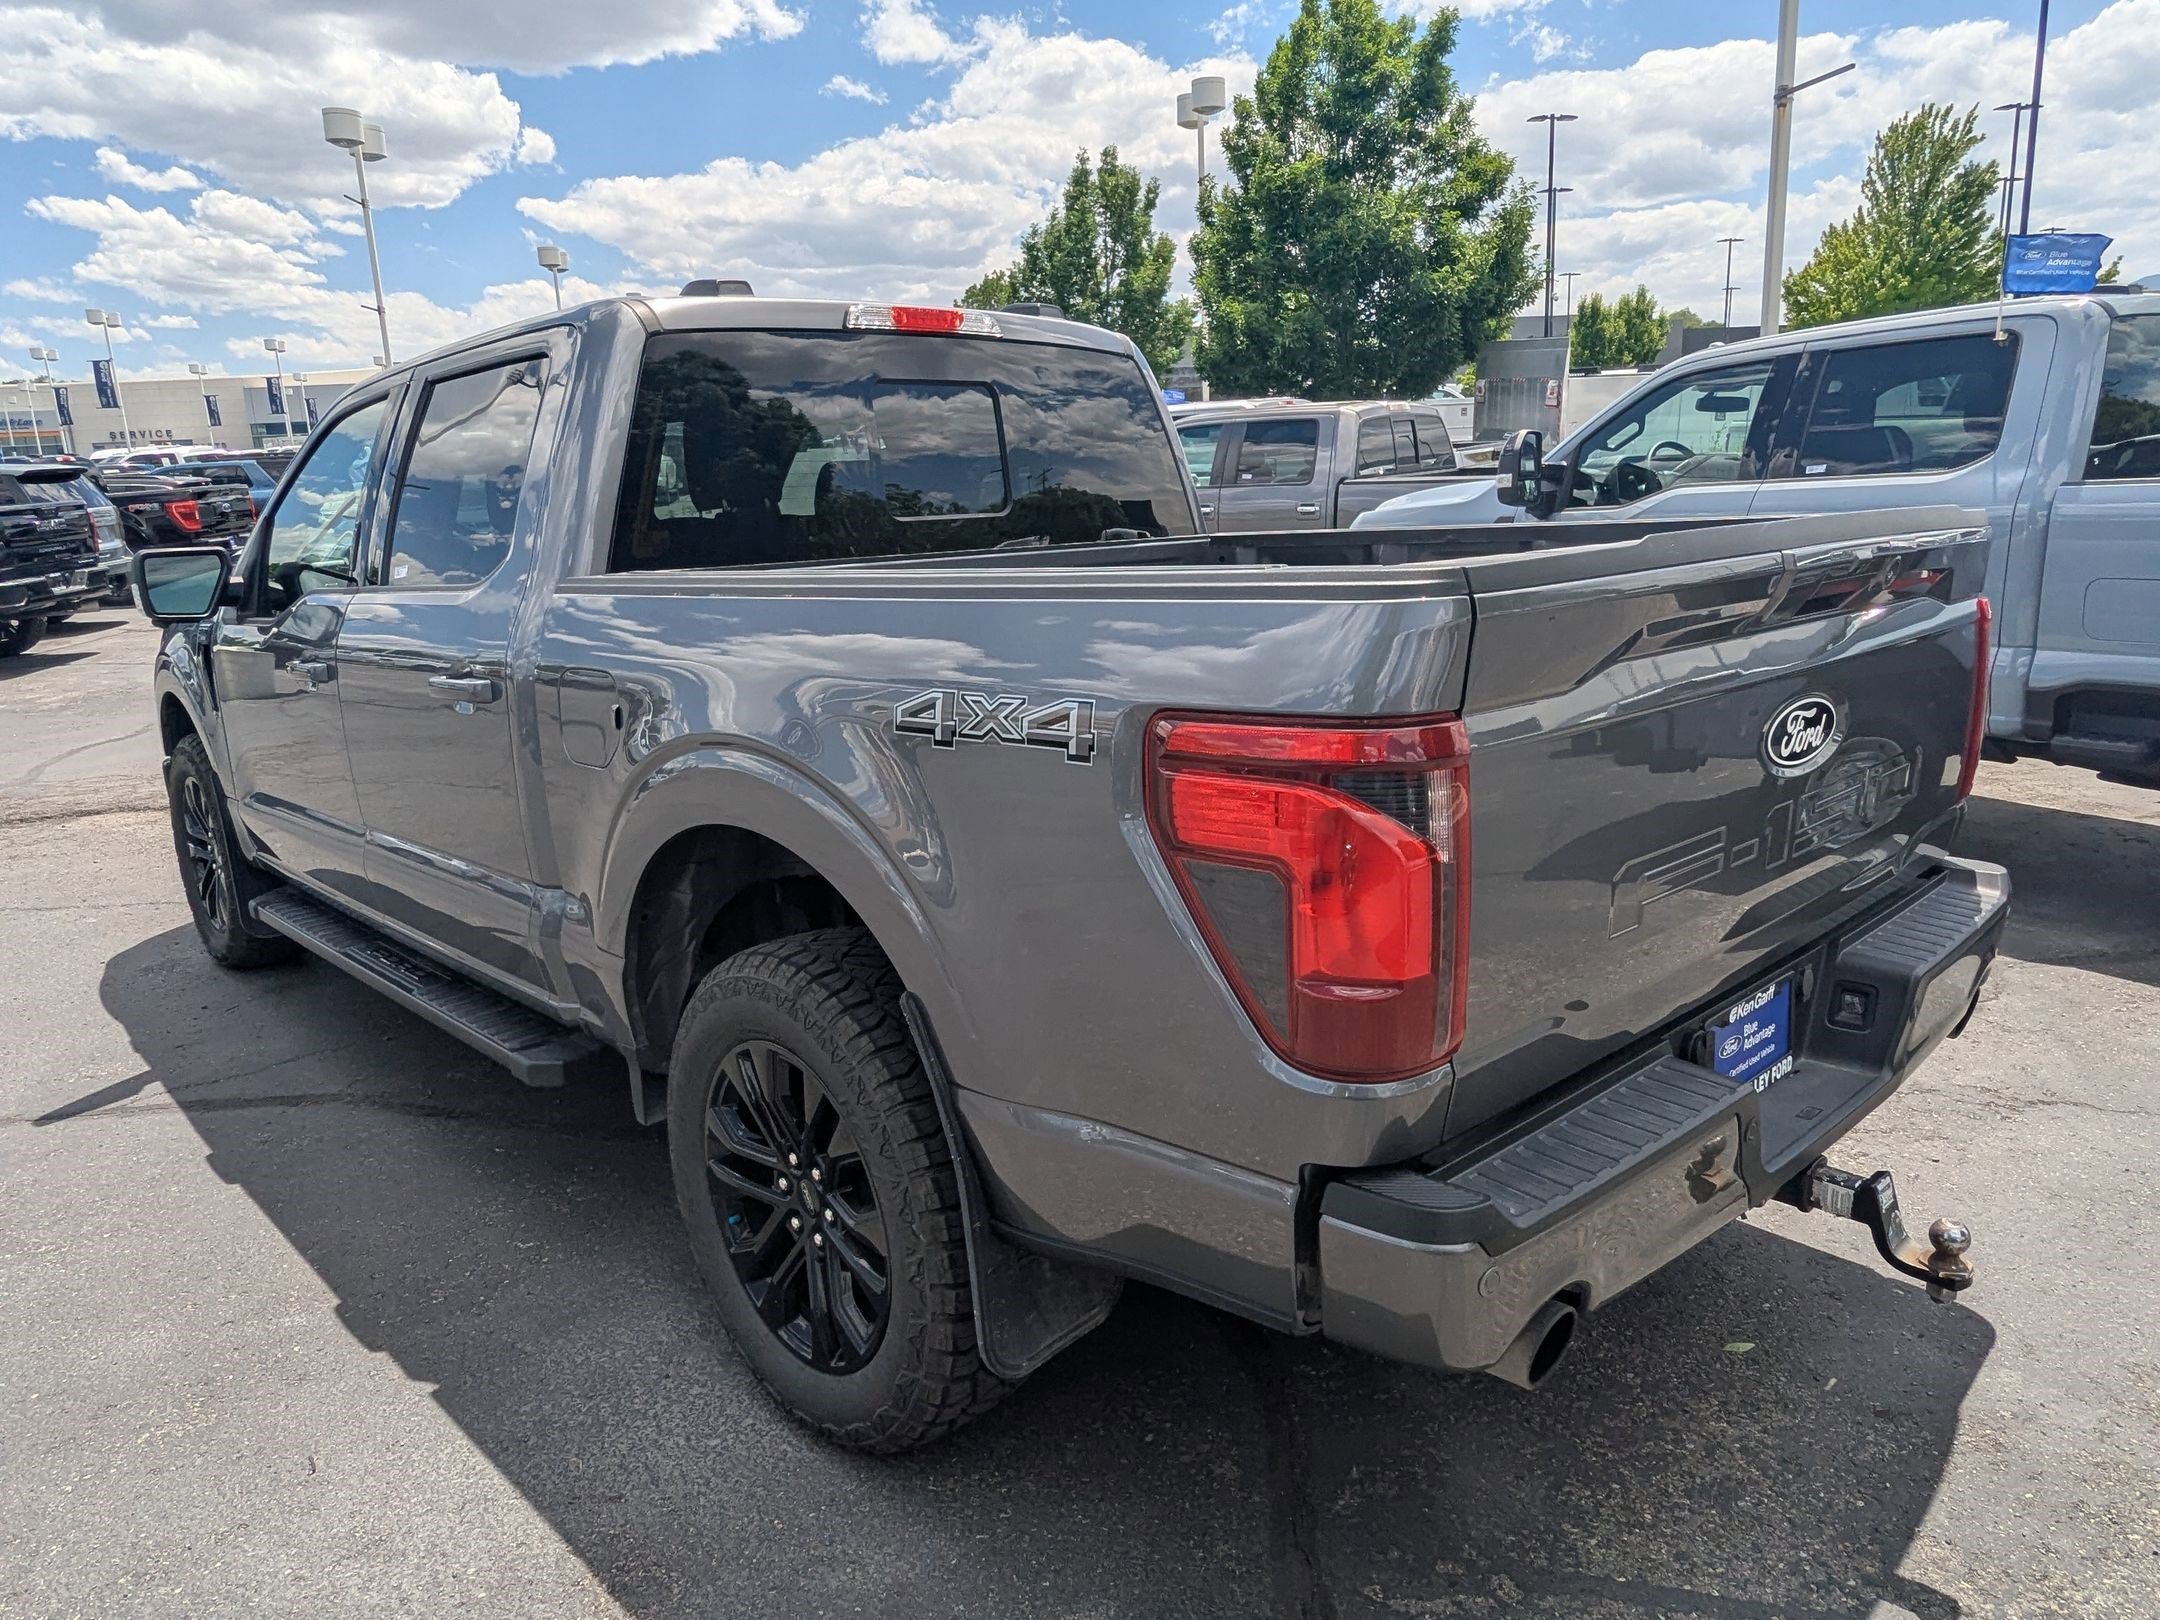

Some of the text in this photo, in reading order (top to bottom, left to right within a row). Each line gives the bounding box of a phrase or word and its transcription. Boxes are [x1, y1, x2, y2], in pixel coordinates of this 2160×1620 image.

[2047, 259, 2093, 267] Advantage
[109, 429, 173, 441] SERVICE
[1780, 707, 1827, 757] Ford
[1737, 1001, 1754, 1020] Ken
[1743, 1021, 1758, 1037] Blue
[1743, 1023, 1776, 1051] Advantage
[1748, 1052, 1761, 1066] Used
[1753, 1055, 1793, 1094] LEY FORD
